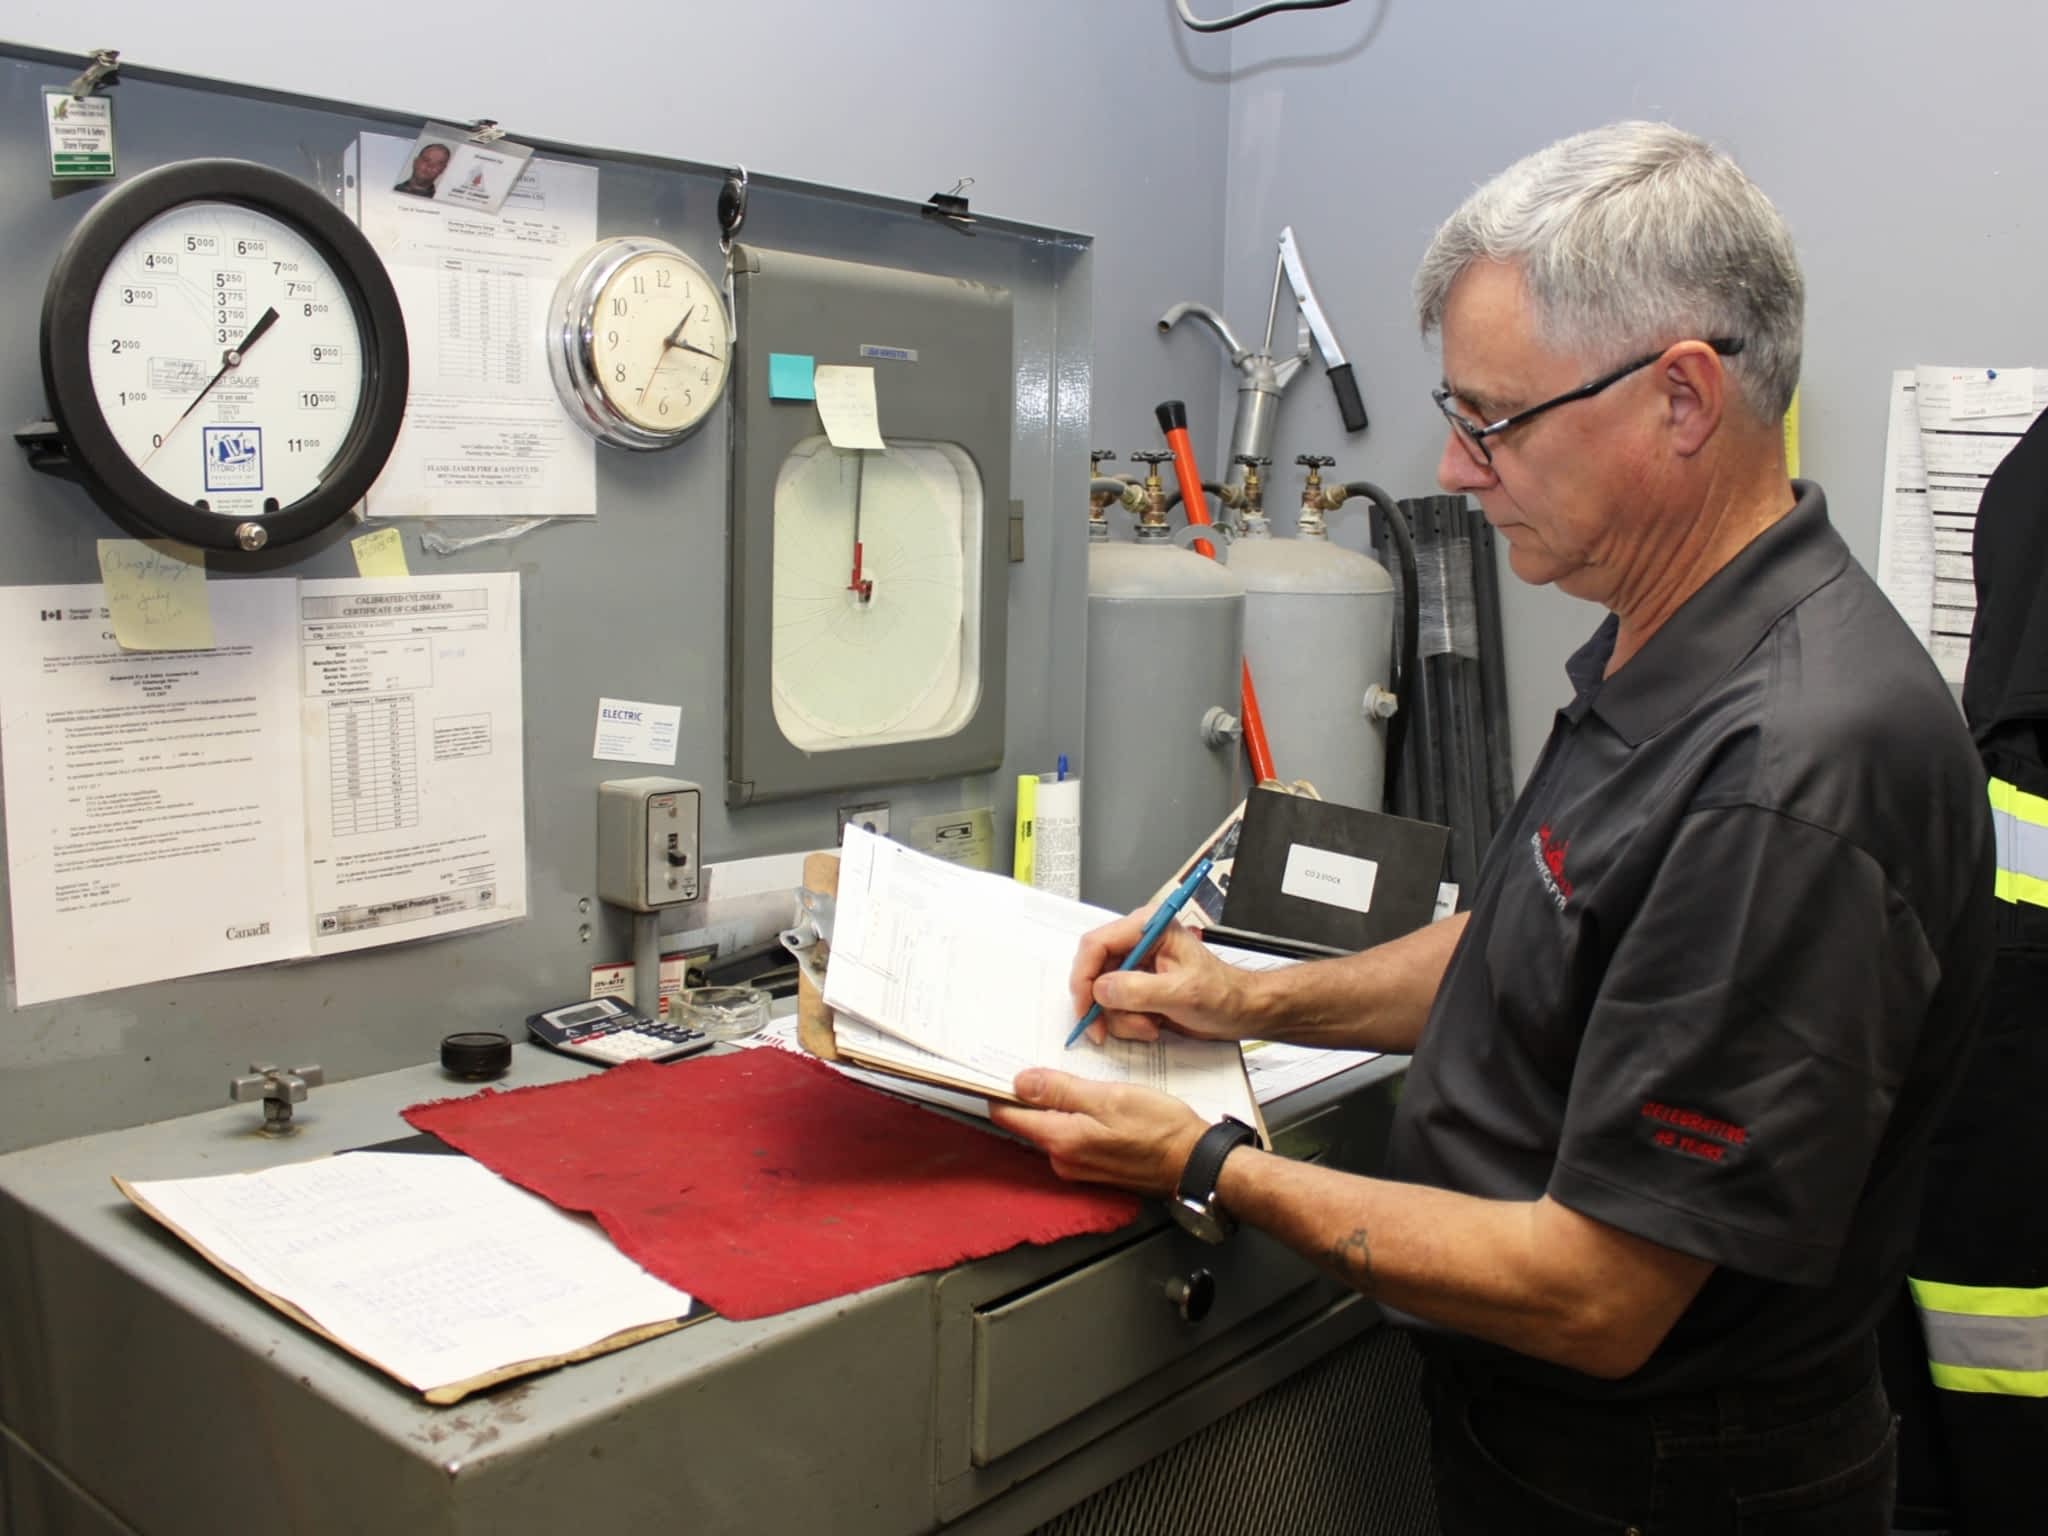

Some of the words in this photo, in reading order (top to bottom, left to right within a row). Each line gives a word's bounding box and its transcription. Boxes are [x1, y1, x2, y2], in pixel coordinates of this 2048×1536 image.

[187, 236, 214, 251] 5000
[238, 241, 264, 255] 6000
[145, 254, 173, 268] 4000
[272, 261, 298, 275] 7000
[216, 273, 242, 287] 5250
[633, 276, 645, 295] 11
[656, 270, 671, 288] 12
[124, 288, 152, 303] 3000
[287, 282, 312, 296] 7500
[684, 280, 691, 298] 1
[303, 303, 328, 317] 8000
[612, 298, 628, 317] 10
[701, 304, 710, 322] 2
[111, 339, 140, 354] 2000
[608, 330, 619, 351] 9
[709, 335, 716, 354] 3
[313, 347, 338, 361] 9000
[231, 375, 259, 385] GAUGE
[615, 363, 626, 383] 8
[700, 367, 710, 385] 4
[119, 392, 147, 406] 1000
[301, 394, 336, 407] 10000
[635, 387, 645, 407] 7
[684, 389, 692, 407] 5
[658, 395, 669, 415] 6
[152, 433, 162, 448] 0
[287, 438, 320, 453] 11000
[602, 708, 644, 722] ELECTRIC
[1321, 873, 1342, 885] STOCK
[225, 921, 271, 941] Canada
